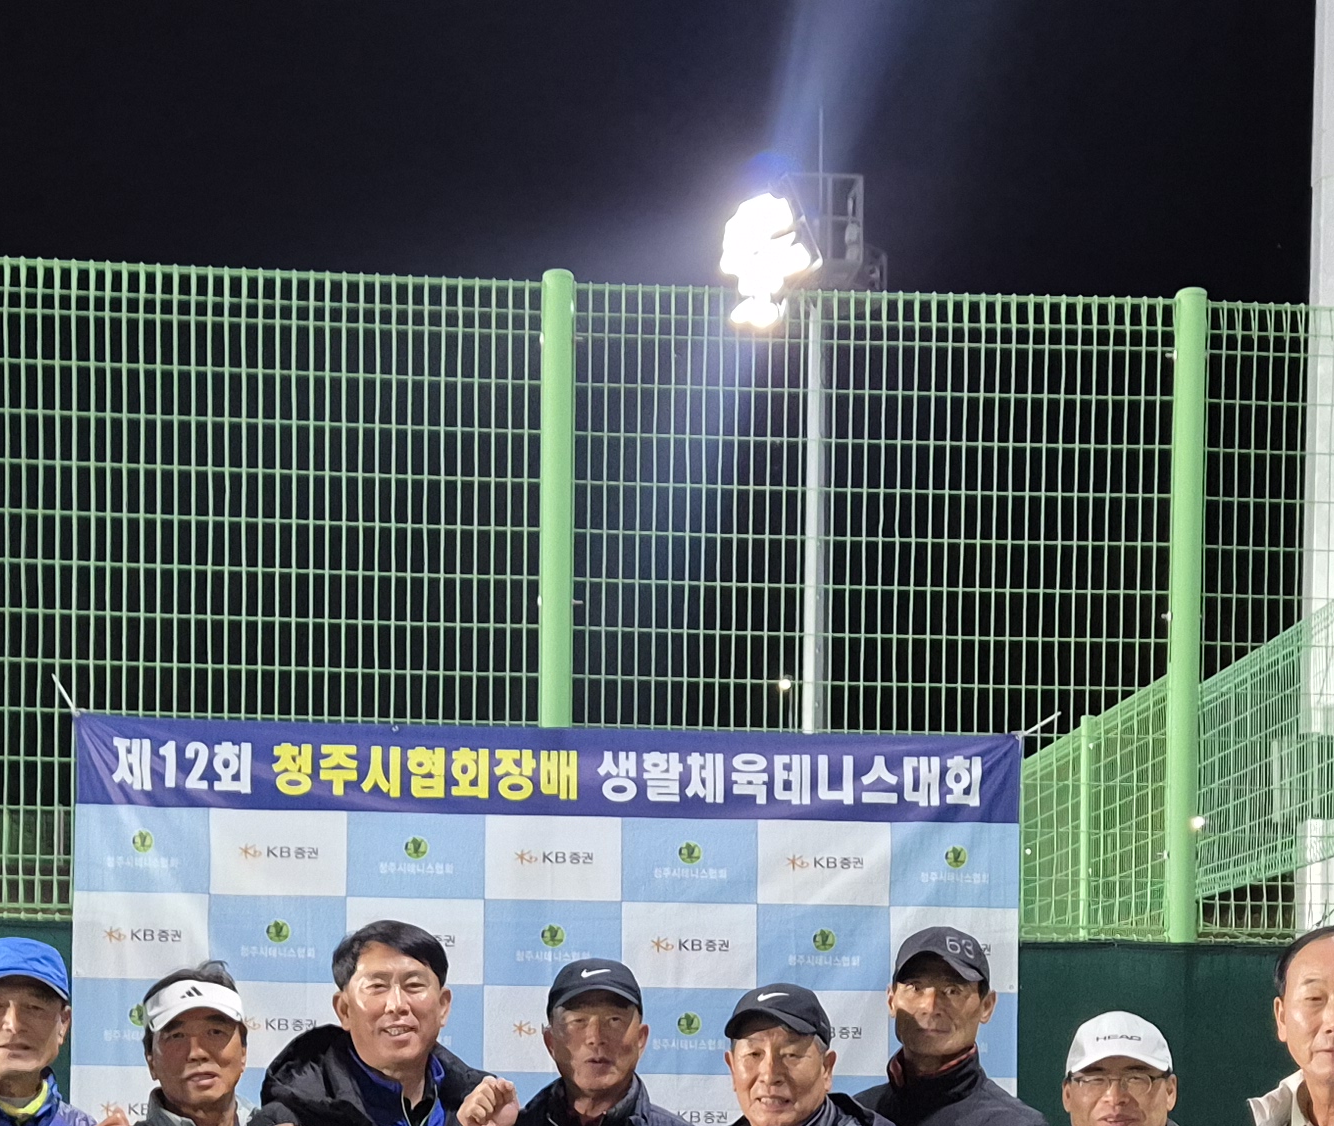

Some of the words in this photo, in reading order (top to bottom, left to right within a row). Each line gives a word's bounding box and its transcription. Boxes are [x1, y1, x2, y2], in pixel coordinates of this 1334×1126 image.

[112, 736, 252, 794] 제12회
[271, 742, 579, 801] 청주시협회장배
[597, 751, 982, 807] 생활체육테니스대회
[1096, 1034, 1142, 1042] HEAD
